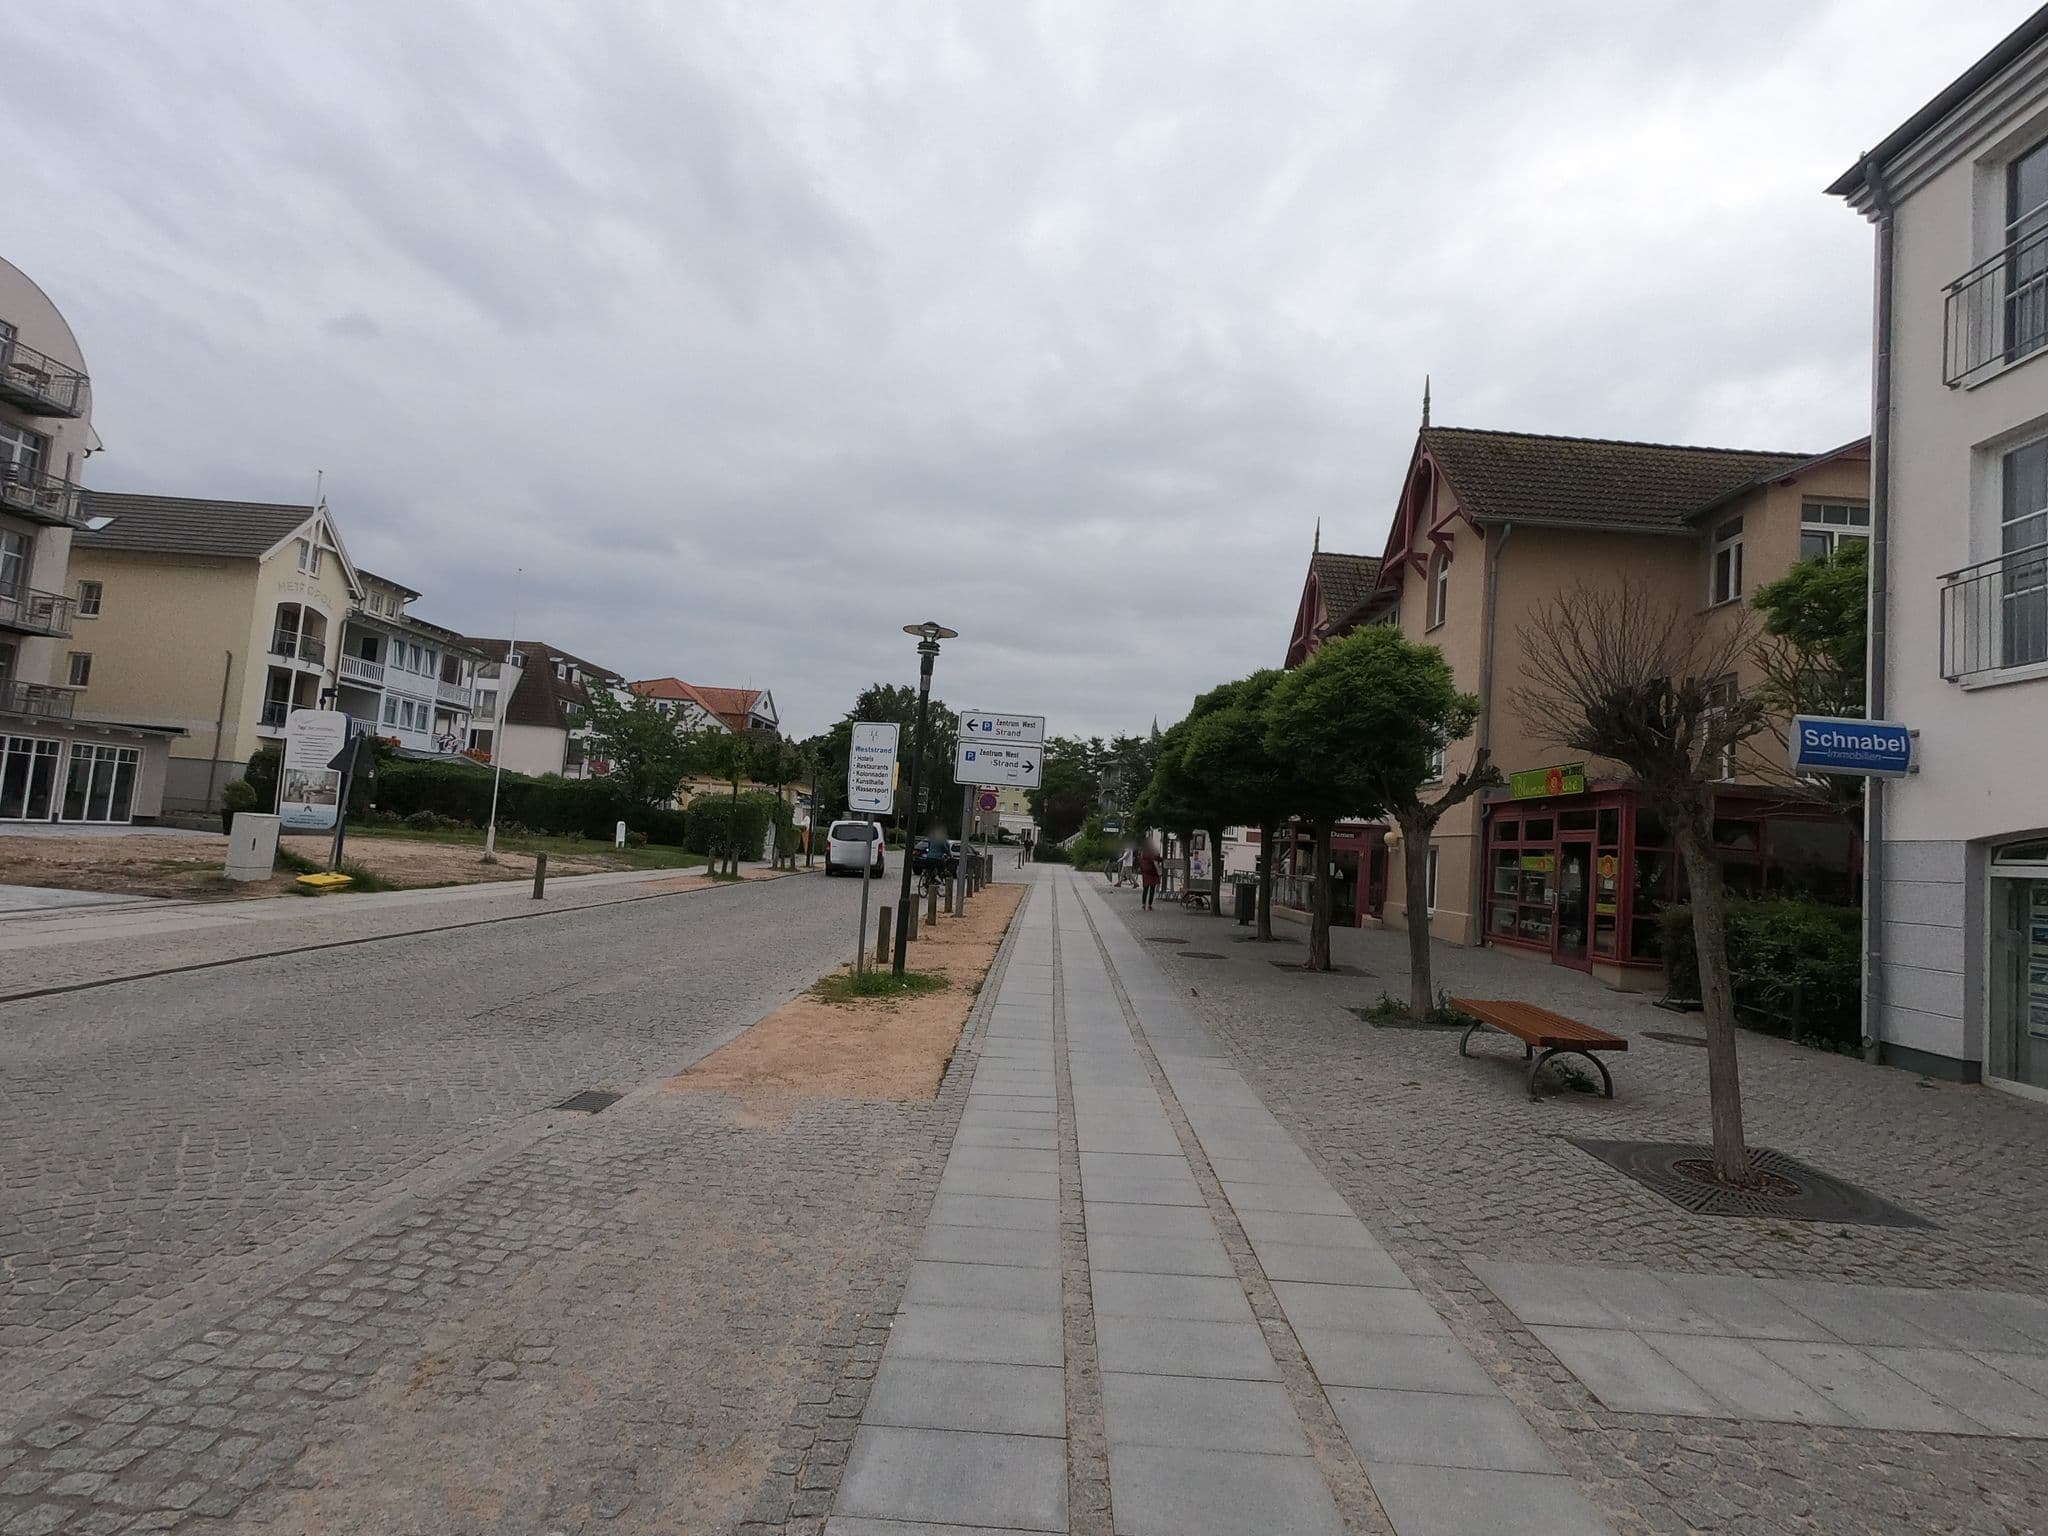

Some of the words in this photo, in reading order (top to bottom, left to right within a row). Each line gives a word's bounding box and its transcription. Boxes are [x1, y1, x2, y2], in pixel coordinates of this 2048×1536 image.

[996, 718, 1020, 727] Zentrum
[1022, 721, 1036, 729] West
[995, 728, 1021, 737] Strand
[1804, 729, 1906, 752] Schnabel
[855, 746, 893, 754] Weststrand
[979, 748, 1003, 758] Zentrum
[1005, 750, 1019, 758] West
[1827, 748, 1881, 761] Immobilien
[856, 763, 889, 771] Restaurants
[993, 759, 1019, 768] Strand
[855, 778, 884, 786] Kunsthalle
[855, 786, 889, 795] Wassersport
